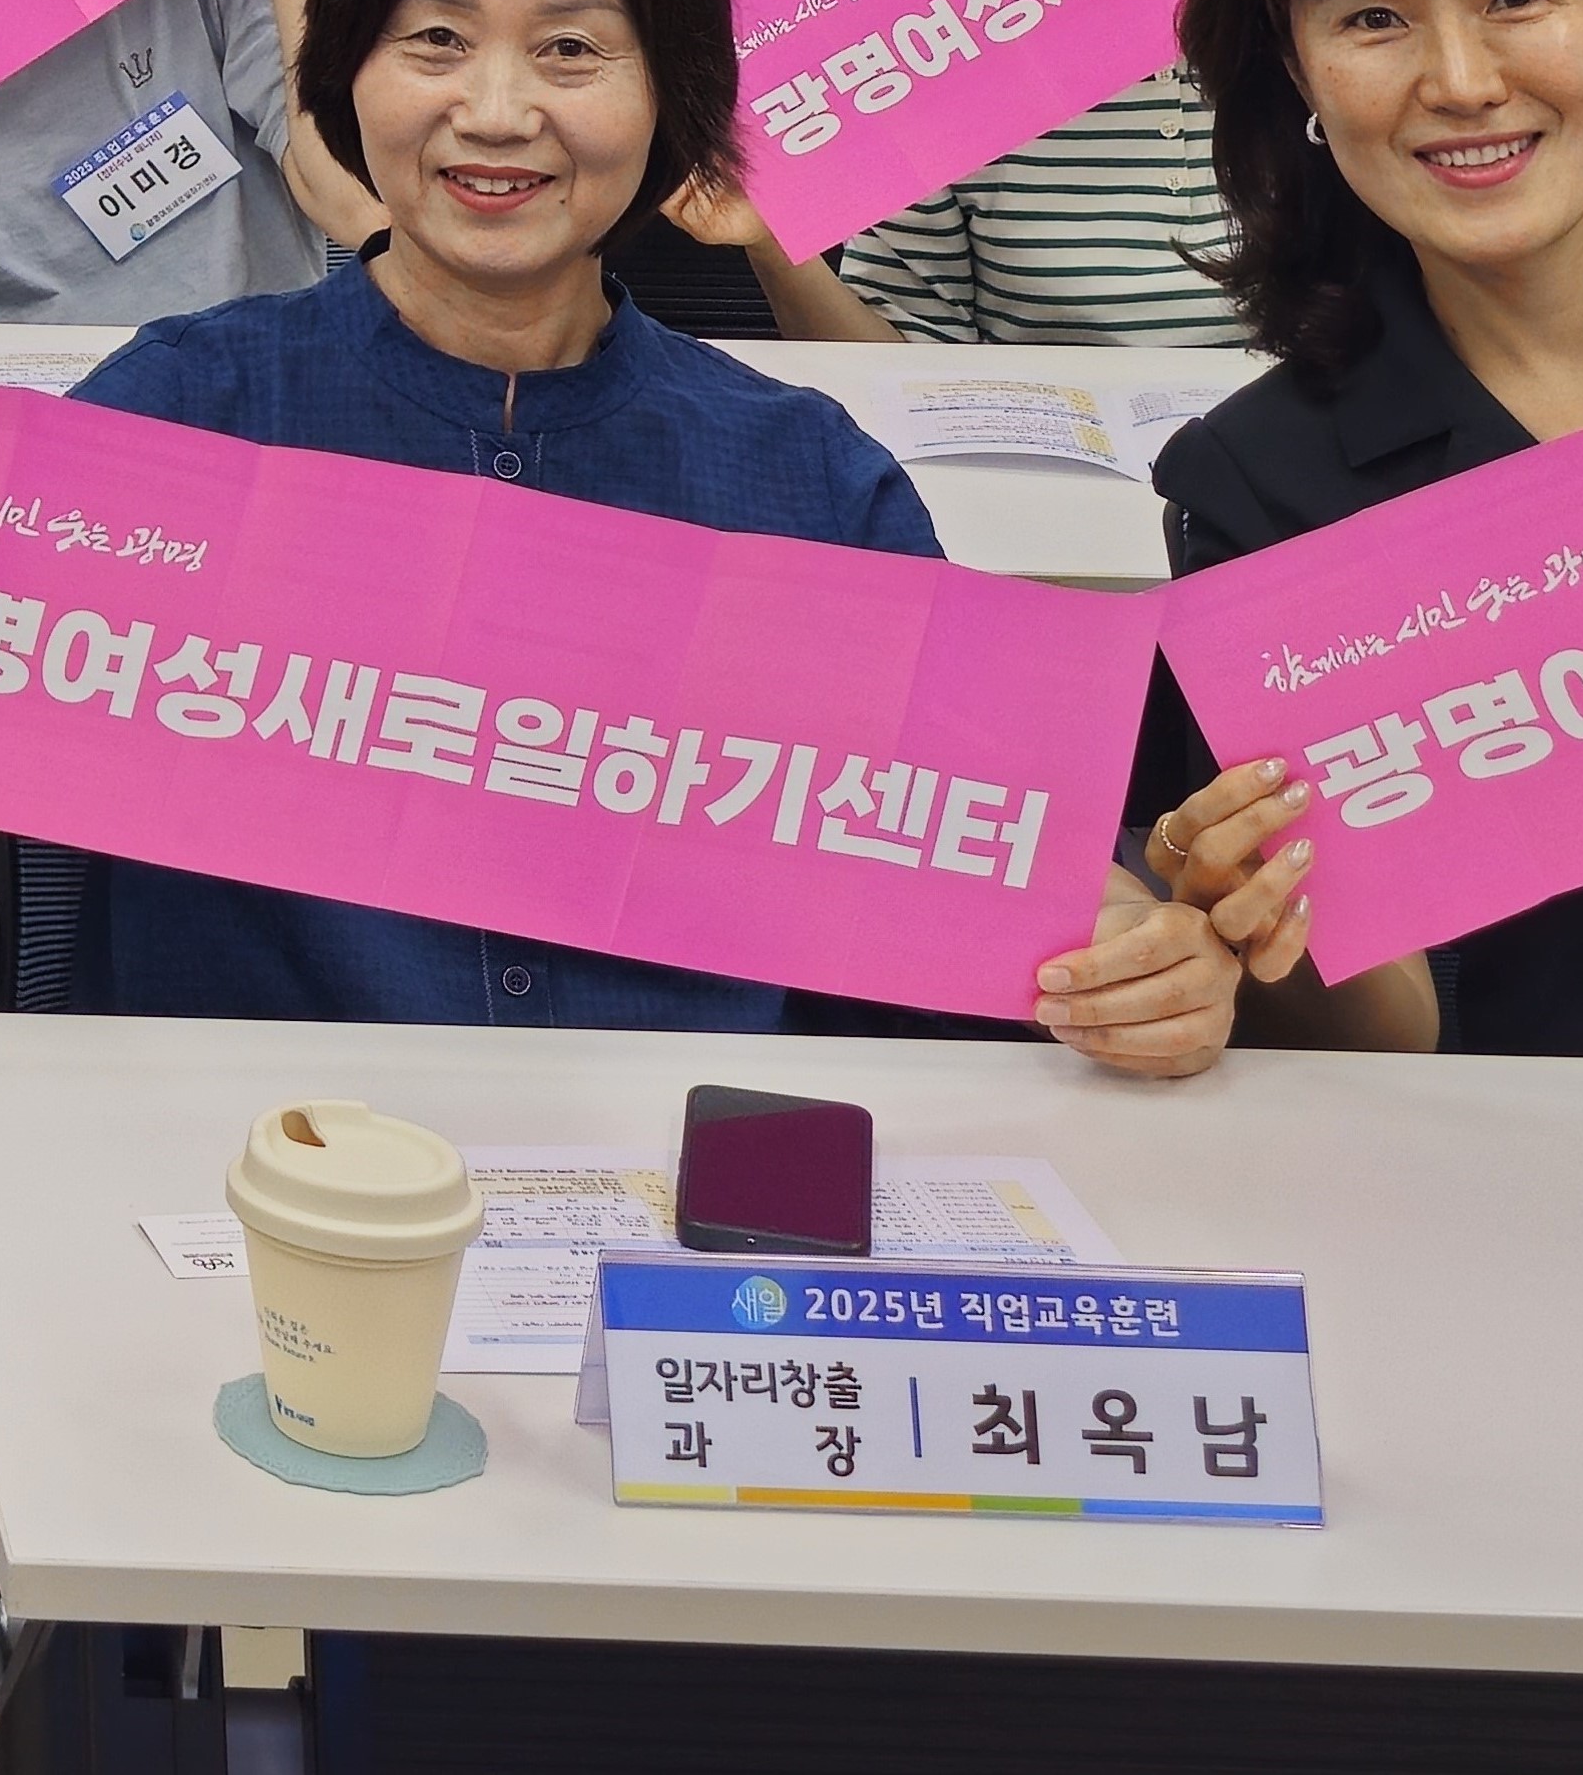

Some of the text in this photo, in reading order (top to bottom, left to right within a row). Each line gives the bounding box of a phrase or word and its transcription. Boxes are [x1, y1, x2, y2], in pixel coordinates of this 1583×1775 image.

[736, 13, 797, 60] 께하는
[98, 134, 202, 218] 이미경
[46, 509, 110, 551] 웃는
[115, 526, 207, 571] 광명
[1261, 634, 1394, 691] 함께하는
[1395, 590, 1466, 642] 시민
[1466, 575, 1537, 622] 웃는
[806, 1289, 943, 1328] 2025년
[957, 1293, 1180, 1343] 직업교육훈련
[656, 1359, 862, 1409] 일자리창출
[973, 1384, 1267, 1477] 최옥남
